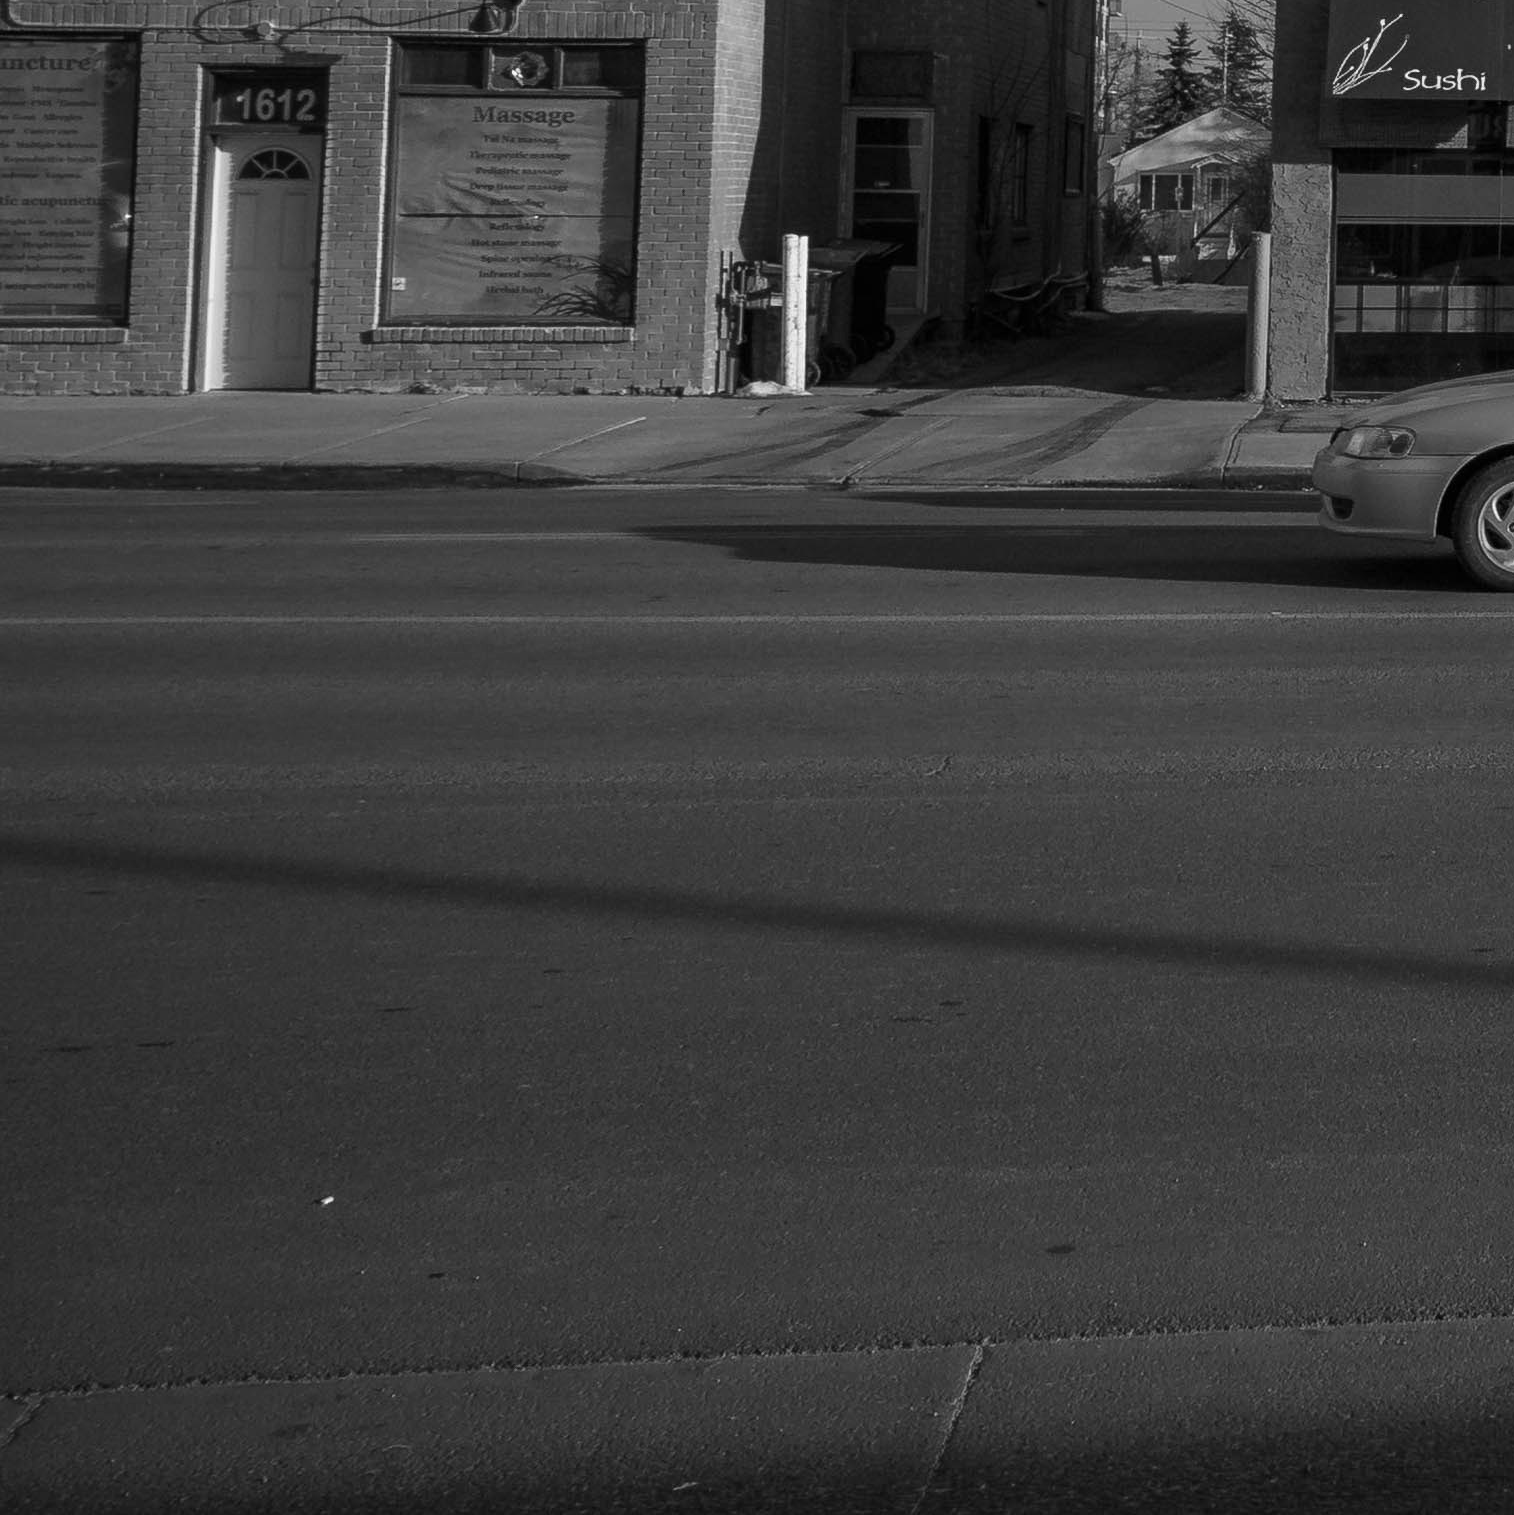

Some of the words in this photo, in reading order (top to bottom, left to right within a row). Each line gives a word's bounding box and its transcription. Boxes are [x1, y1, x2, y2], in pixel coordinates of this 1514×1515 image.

[1403, 68, 1486, 91] Sushi
[238, 87, 316, 122] 1612
[472, 106, 577, 128] Massage
